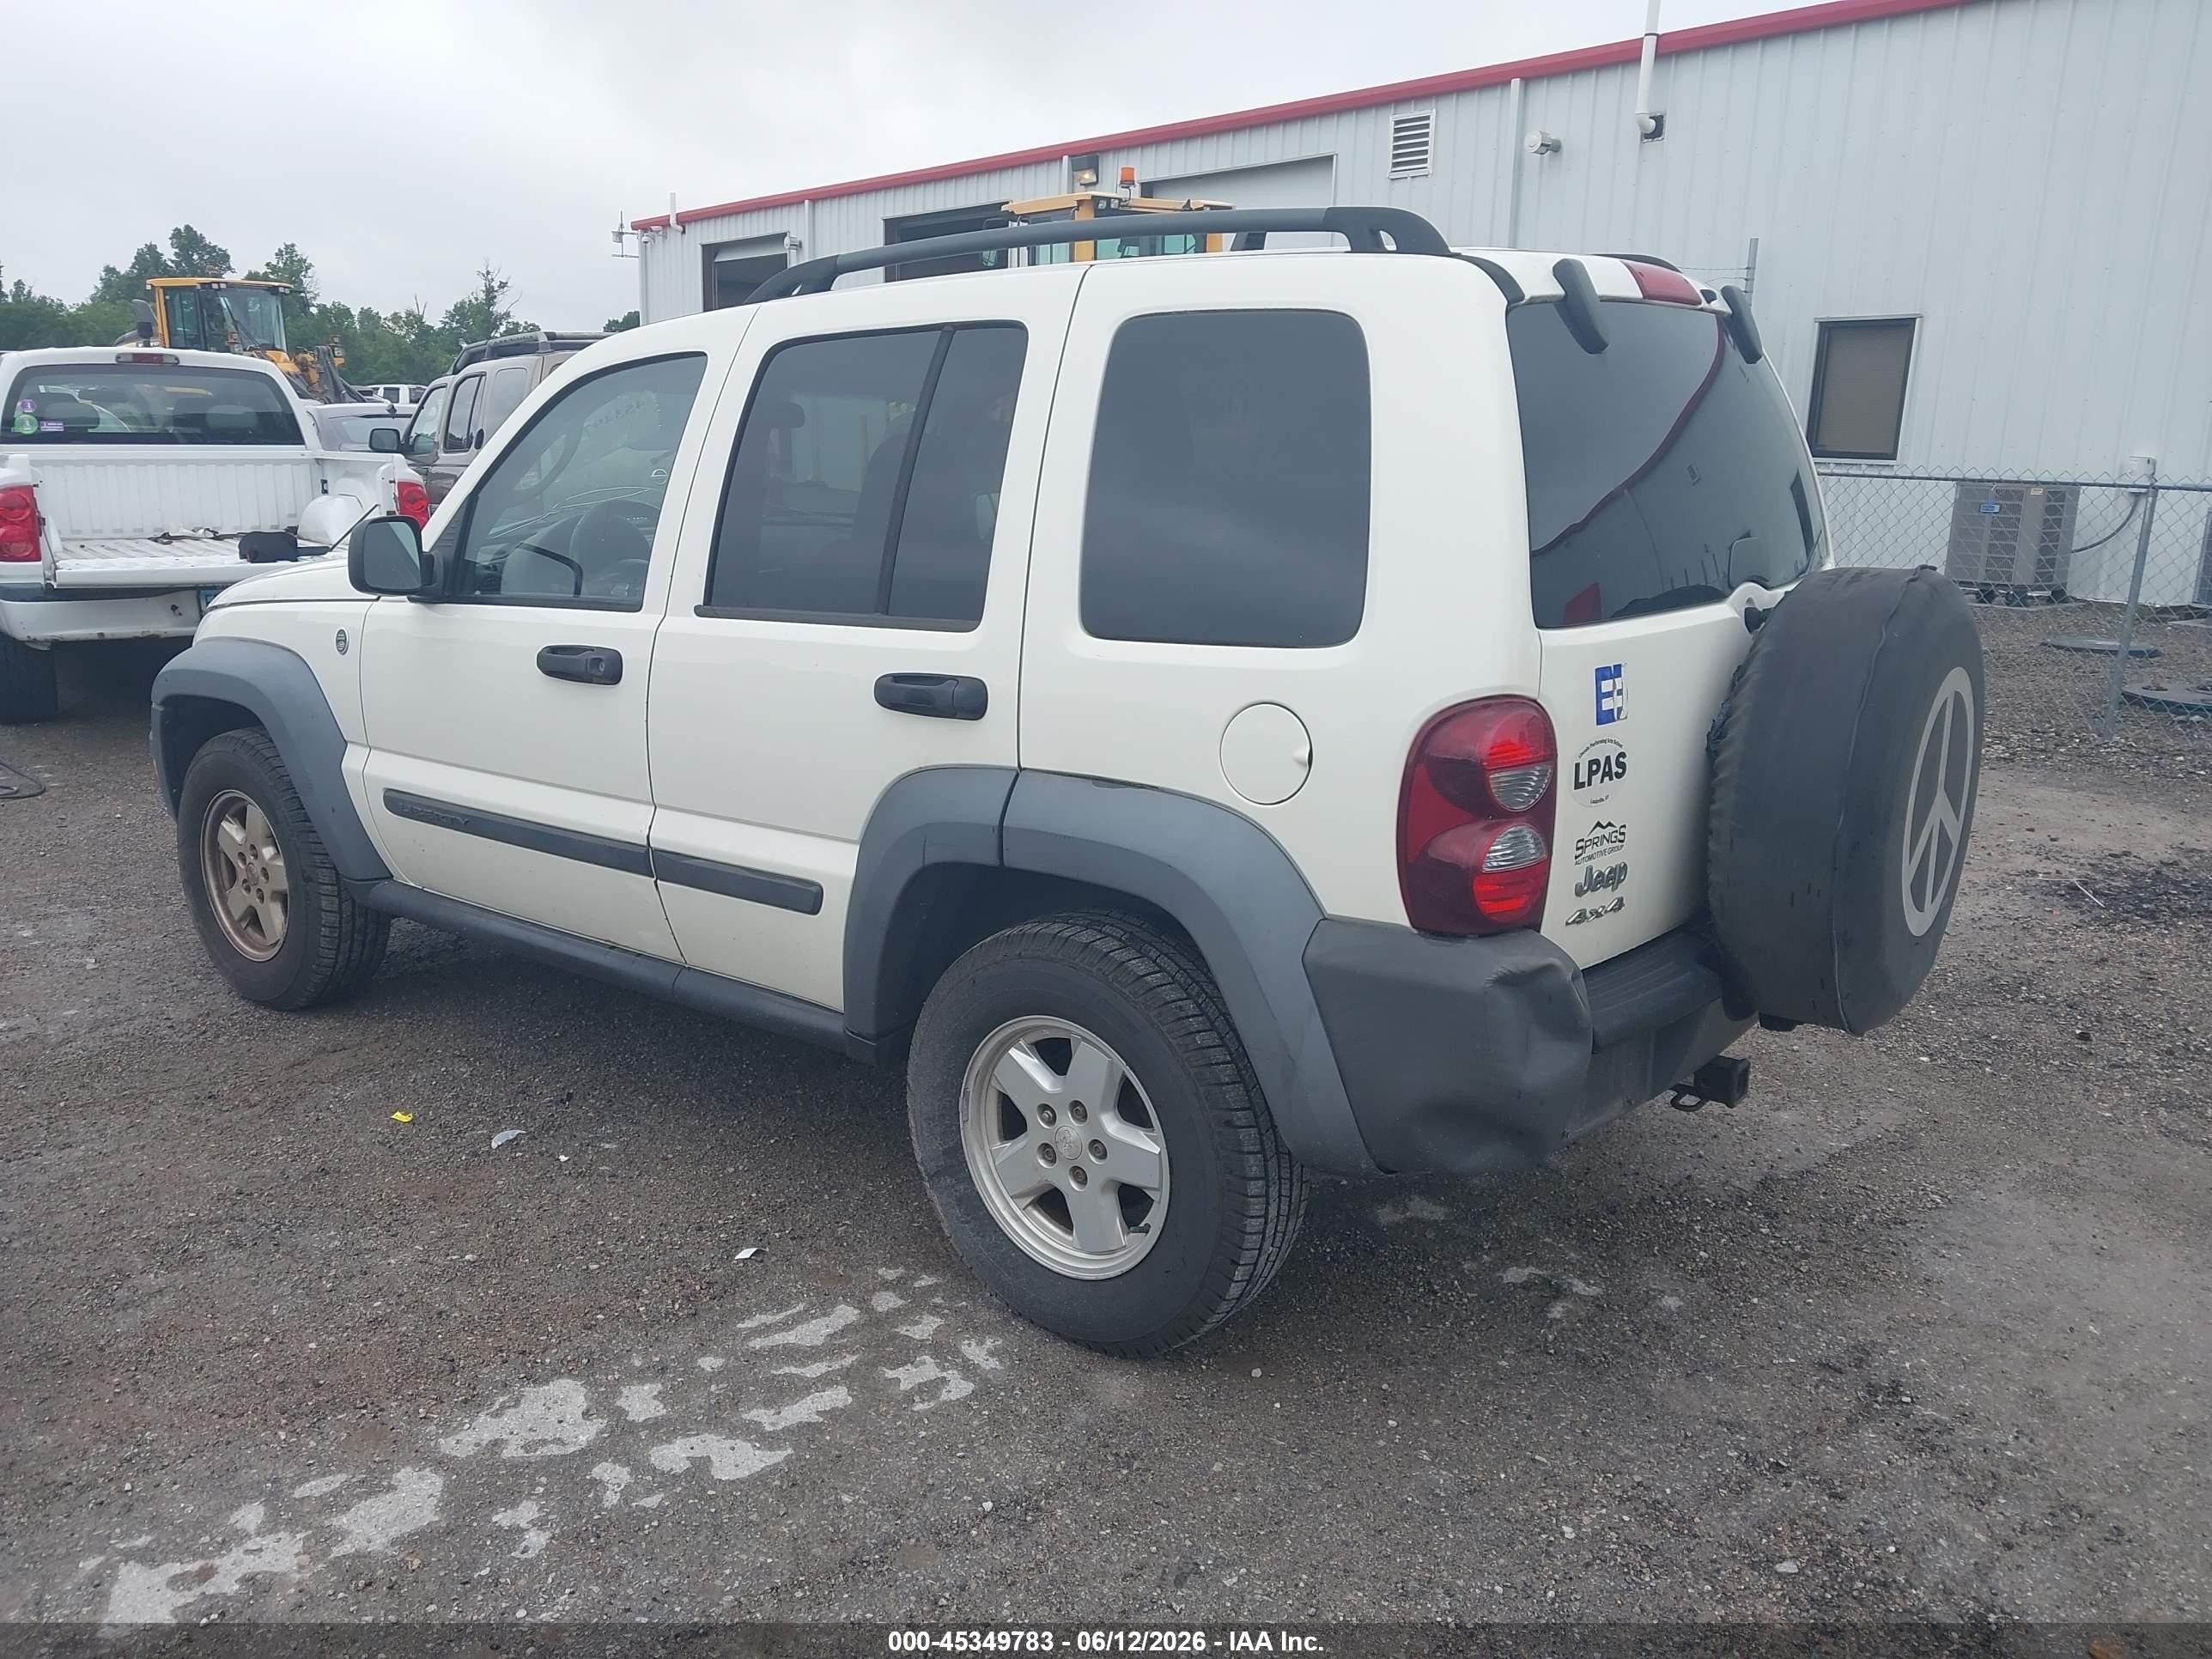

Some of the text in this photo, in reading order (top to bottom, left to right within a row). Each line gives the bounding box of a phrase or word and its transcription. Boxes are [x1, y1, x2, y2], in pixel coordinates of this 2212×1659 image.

[1574, 751, 1627, 790] LPAS
[1574, 824, 1627, 860] SPRINGS
[1574, 845, 1625, 866] AUTOMOTIVE GROUP
[1575, 861, 1628, 897] Jeep
